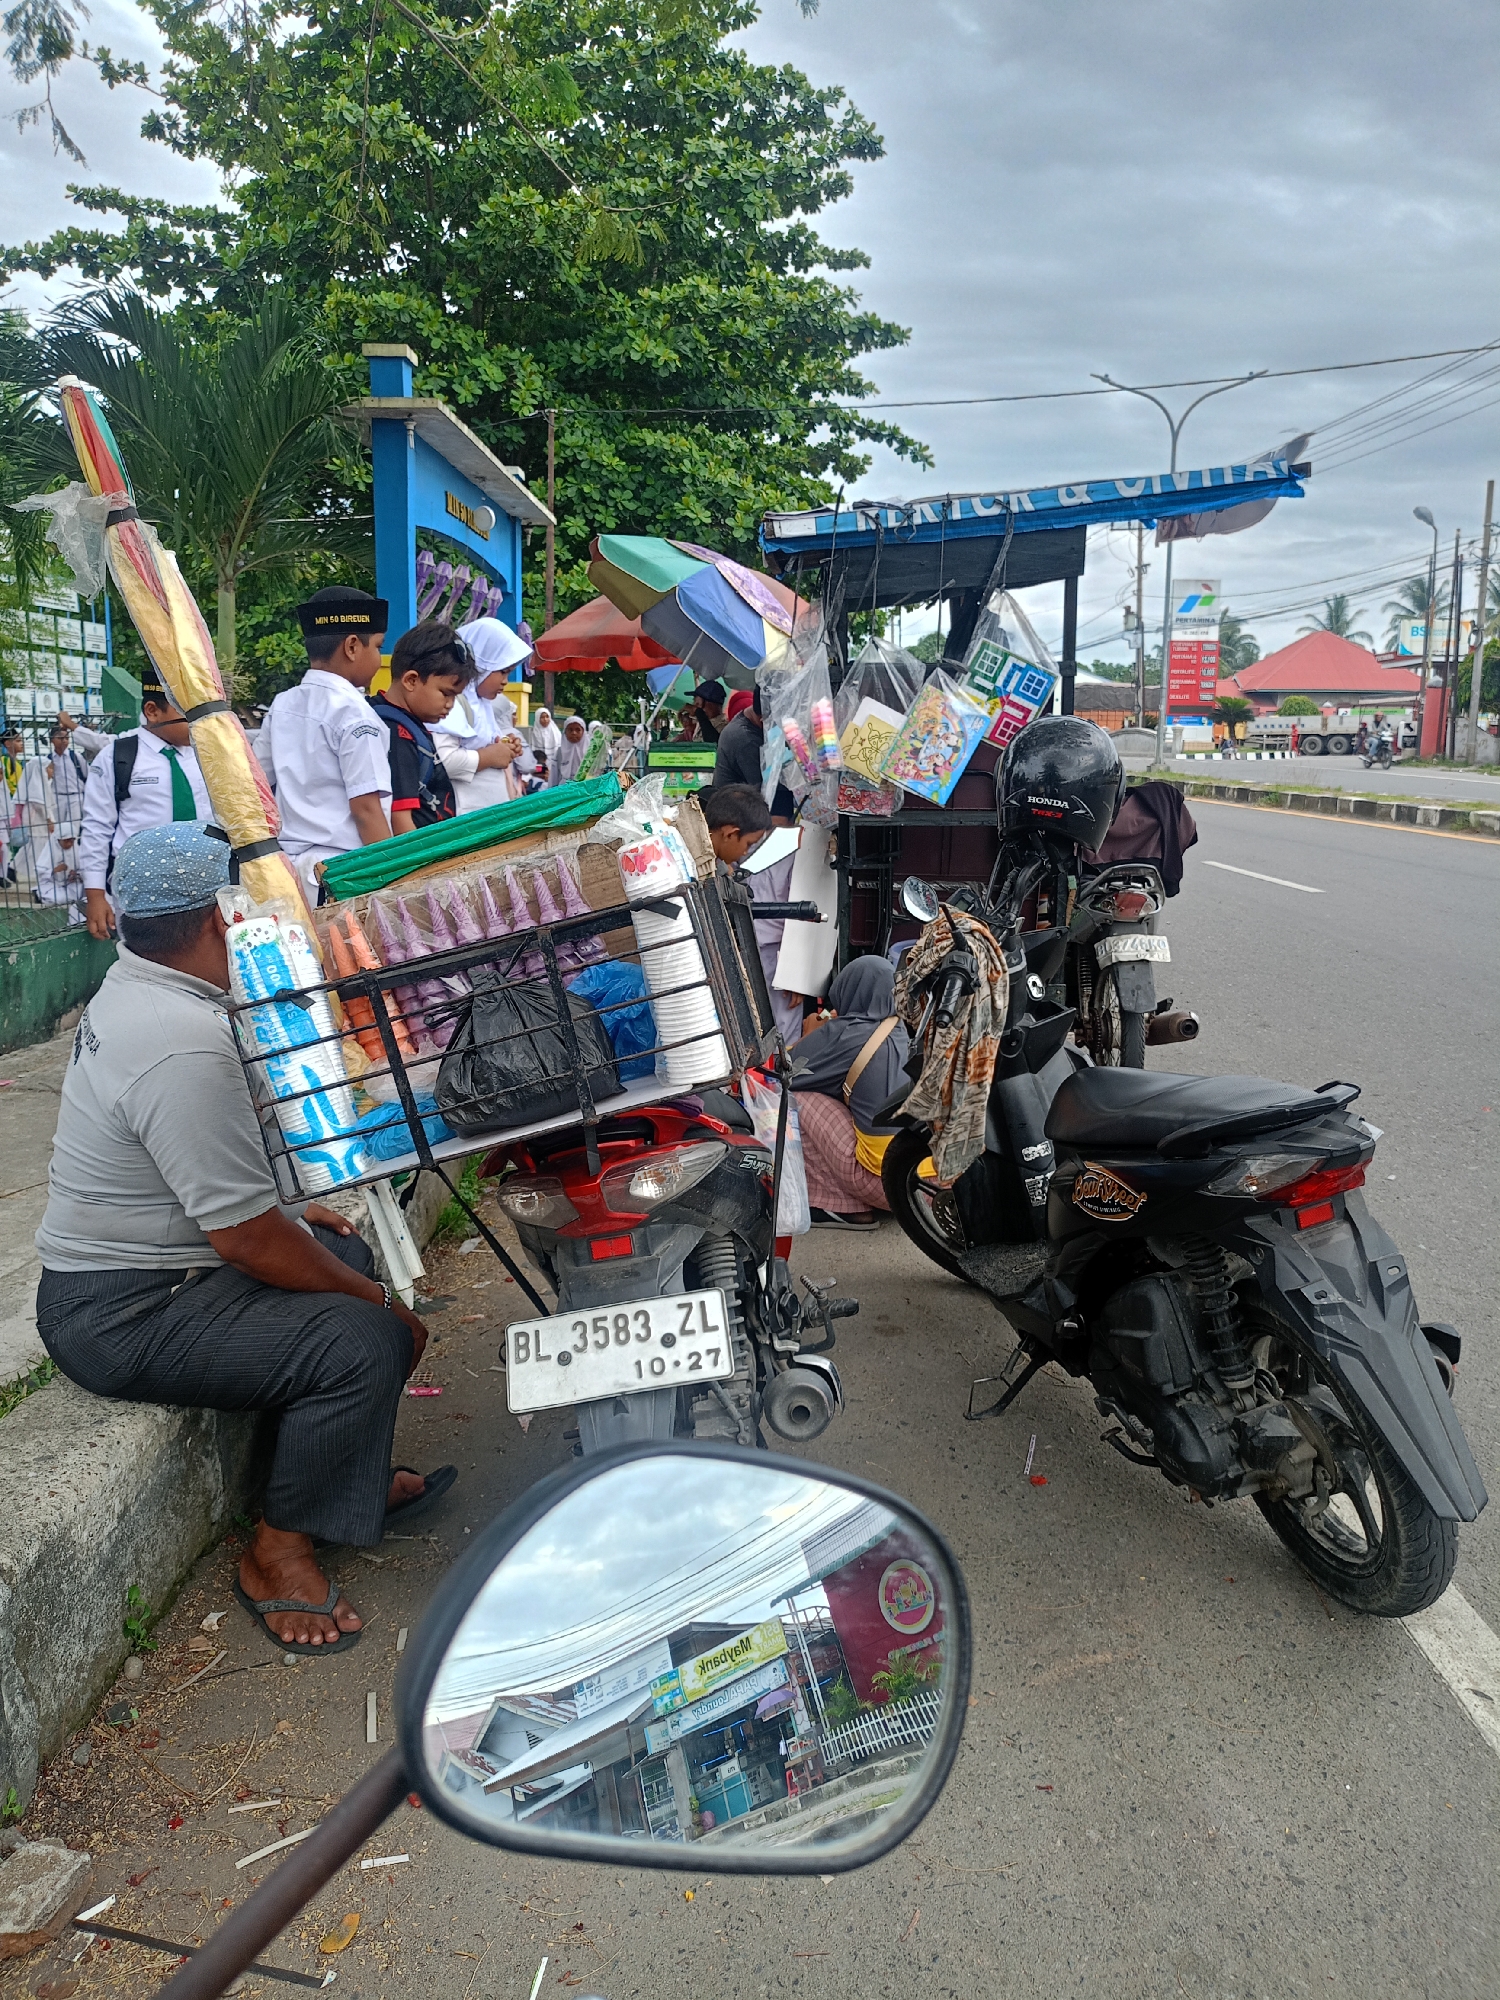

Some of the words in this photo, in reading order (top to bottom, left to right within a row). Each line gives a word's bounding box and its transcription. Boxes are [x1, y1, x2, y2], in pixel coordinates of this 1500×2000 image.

[315, 616, 329, 625] MIN
[340, 614, 370, 623] BIREUEN
[1027, 795, 1070, 809] HONDA
[266, 964, 283, 988] 100
[514, 1329, 552, 1364] BL
[571, 1309, 652, 1353] 3583
[677, 1300, 720, 1336] ZL
